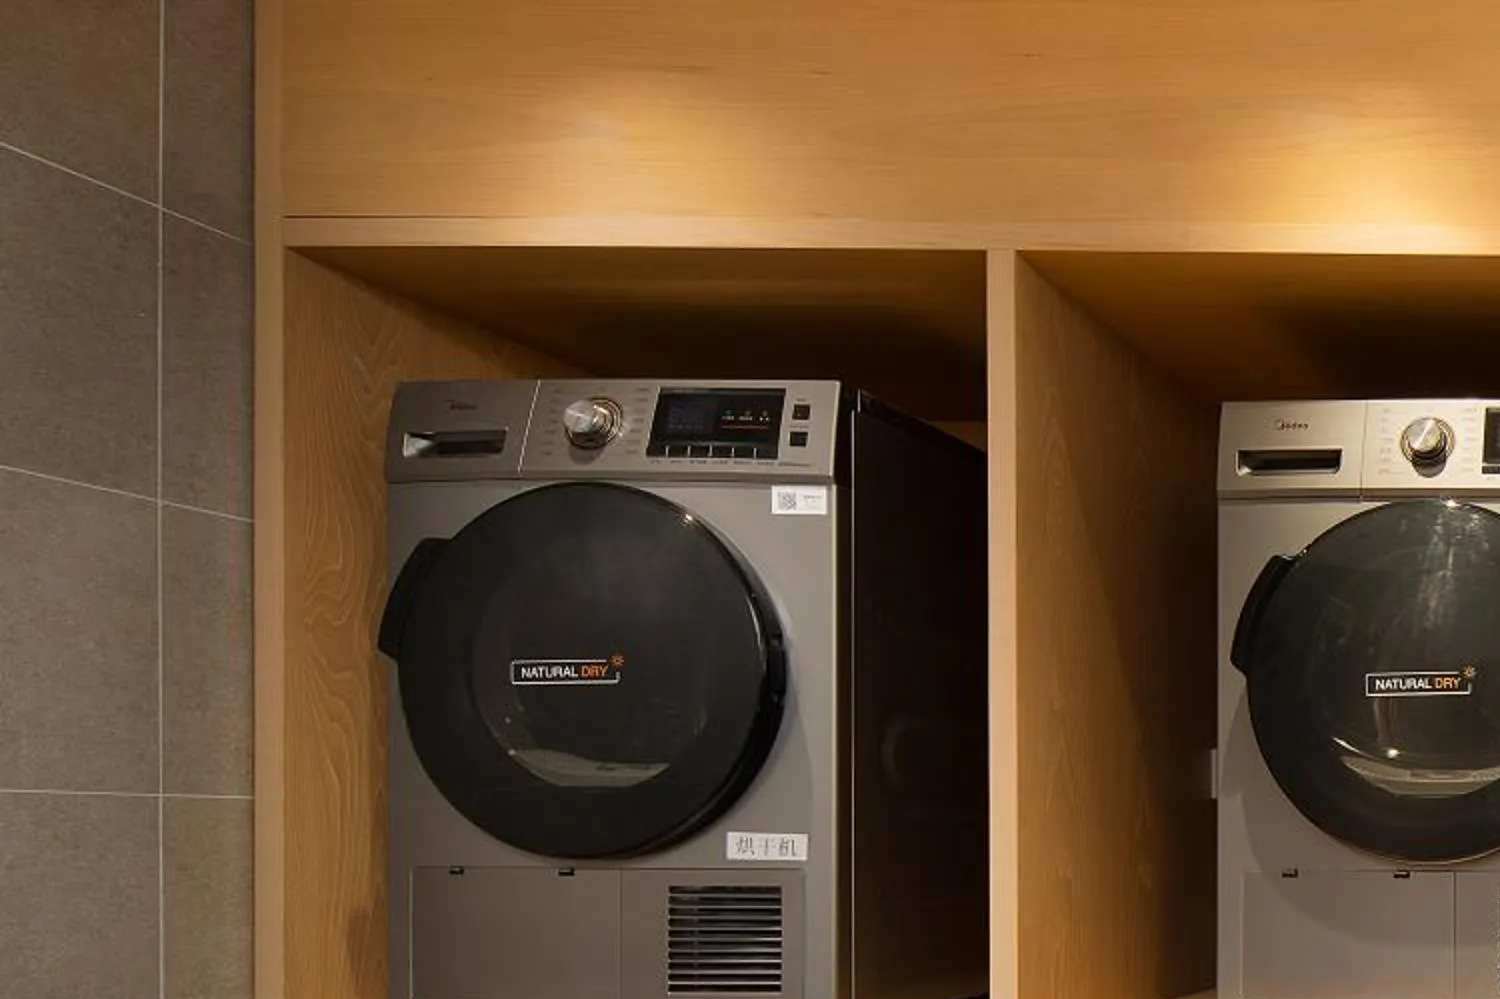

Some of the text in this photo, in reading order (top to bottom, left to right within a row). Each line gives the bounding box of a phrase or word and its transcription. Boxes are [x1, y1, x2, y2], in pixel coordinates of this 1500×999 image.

[520, 665, 608, 679] NATURAL DRY
[1375, 677, 1461, 691] NATURAL DRY
[735, 836, 797, 857] 烘干机
